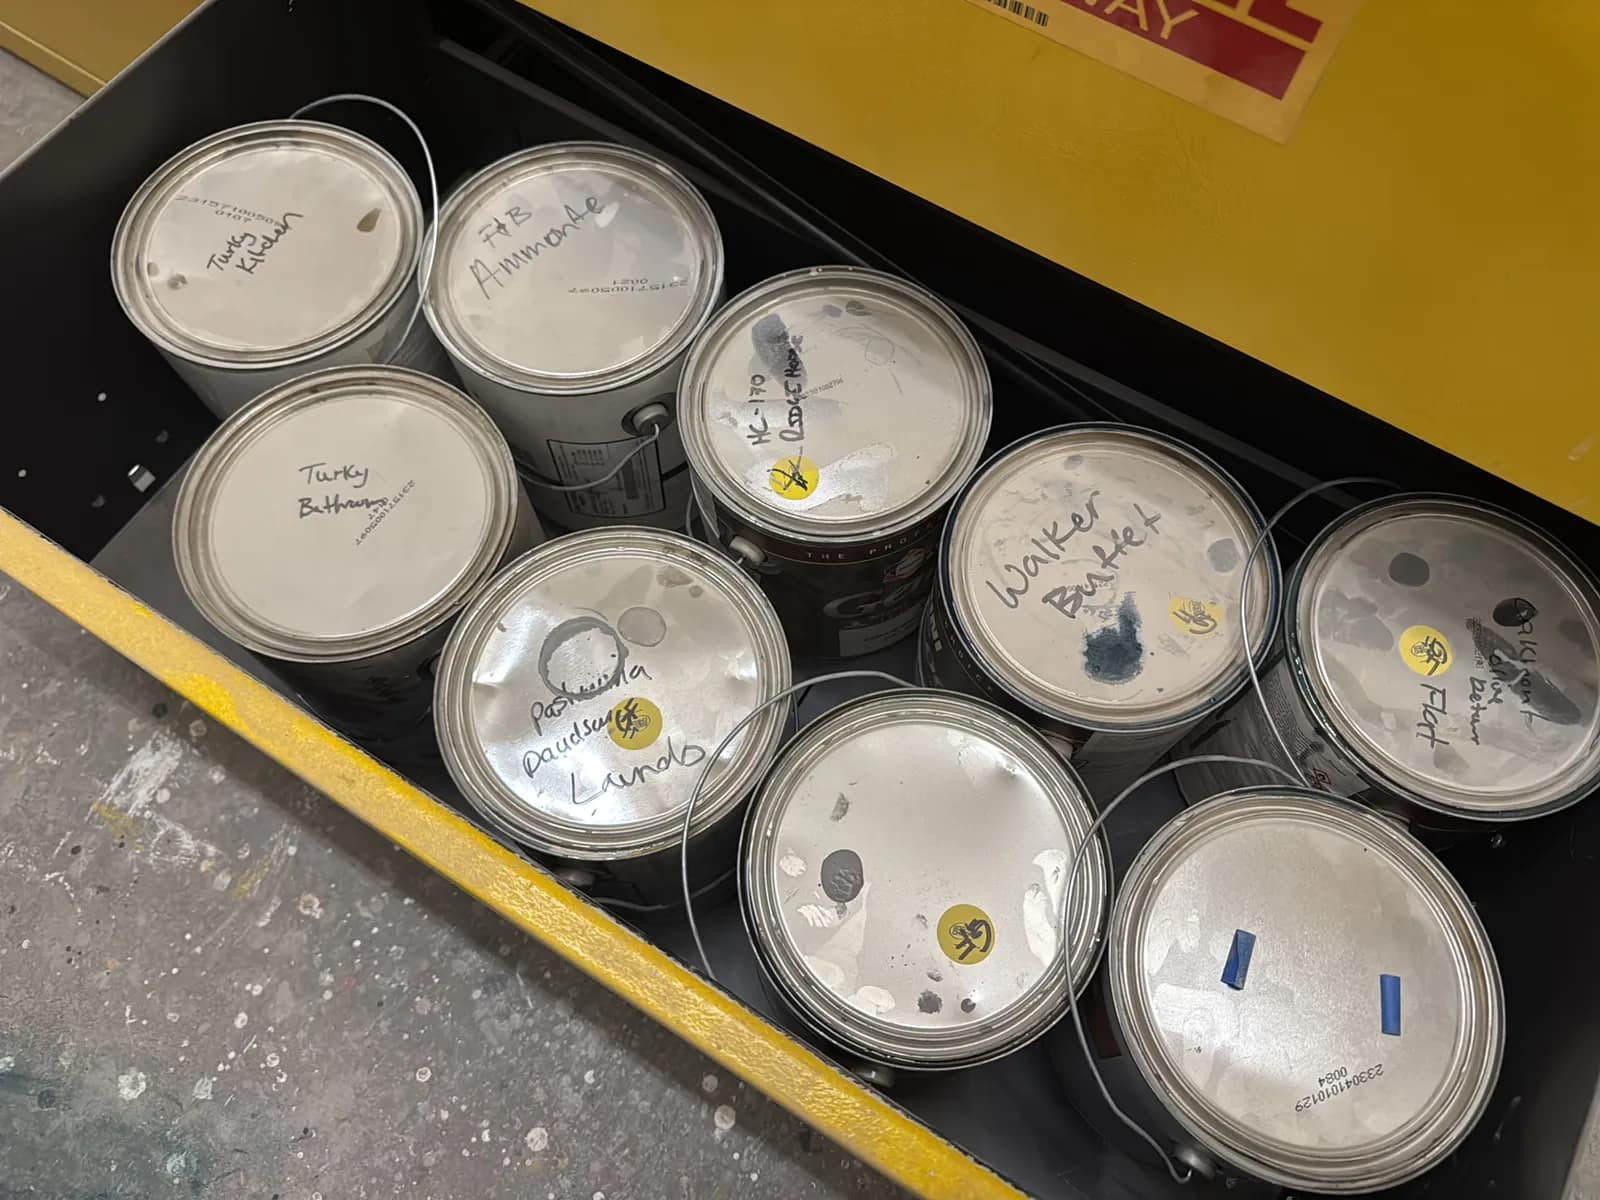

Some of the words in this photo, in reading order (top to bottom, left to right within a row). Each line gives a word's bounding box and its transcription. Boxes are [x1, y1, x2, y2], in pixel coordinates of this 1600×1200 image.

[1086, 0, 1199, 40] AY
[985, 490, 1100, 609] Walker
[1295, 1063, 1385, 1113] 233041010129
[1318, 1066, 1348, 1088] 0084
